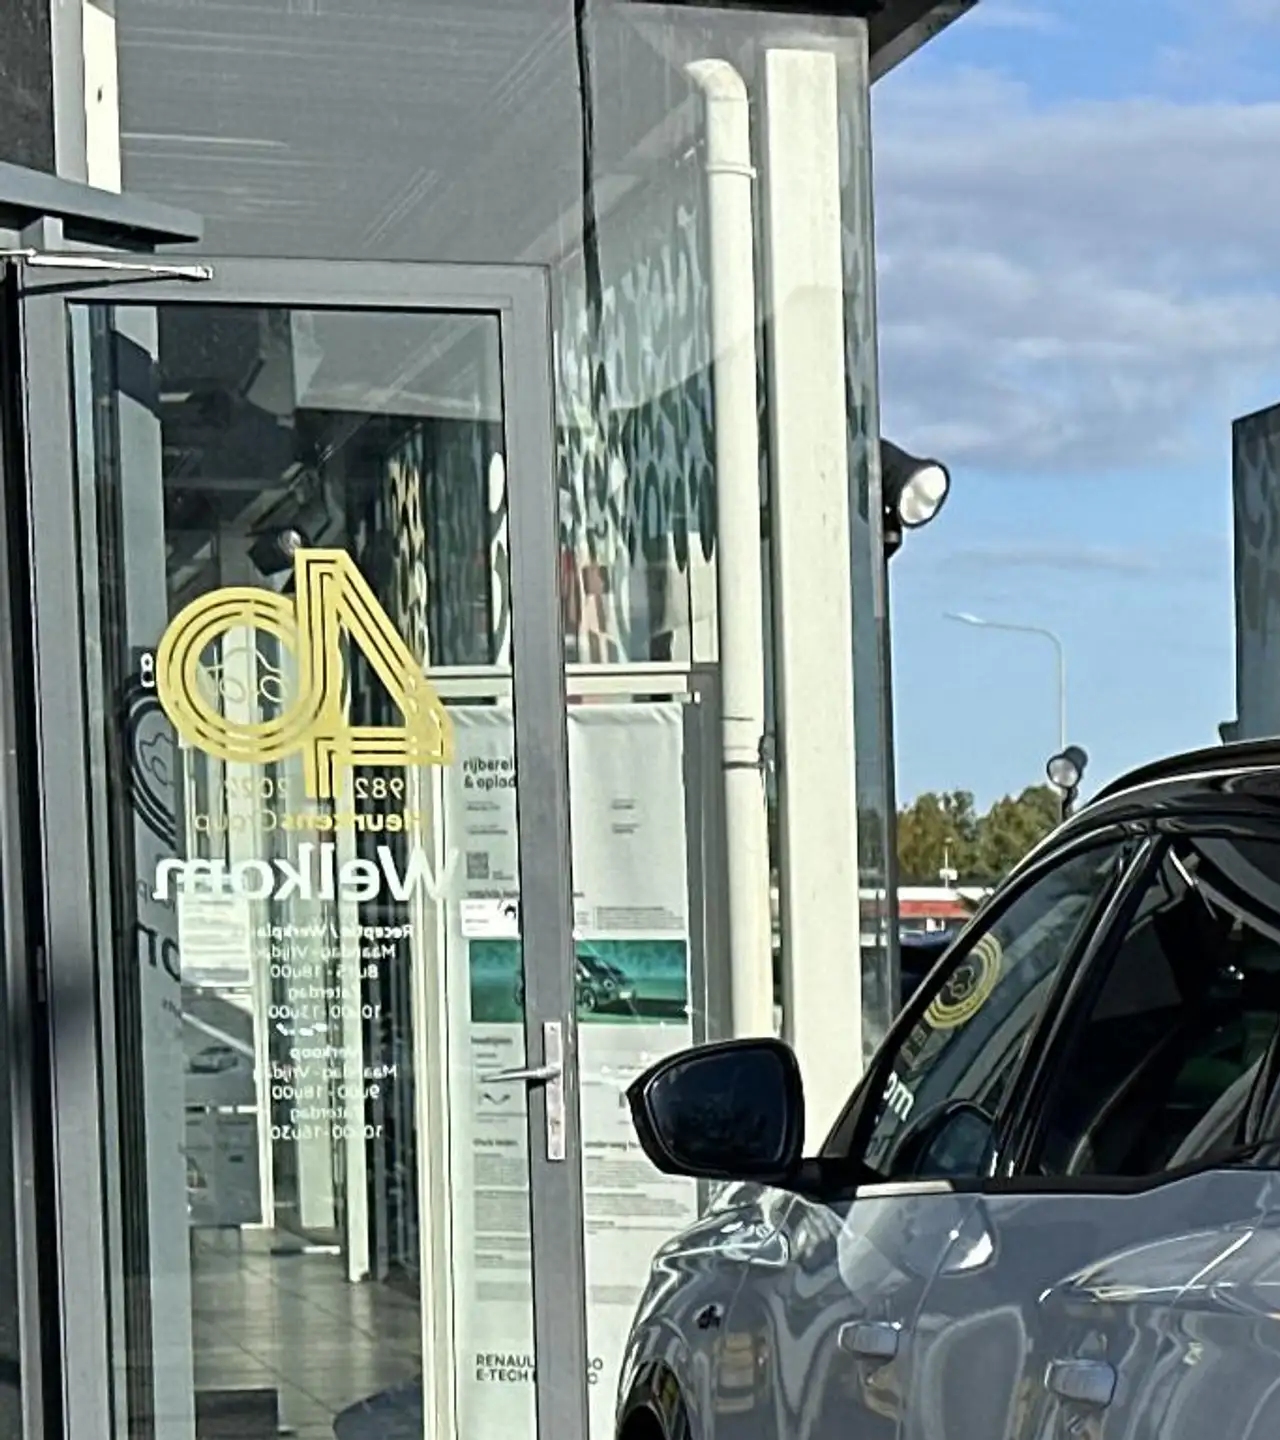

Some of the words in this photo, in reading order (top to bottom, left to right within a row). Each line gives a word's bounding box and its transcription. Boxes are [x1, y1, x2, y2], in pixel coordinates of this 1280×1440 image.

[463, 755, 514, 775] rijberei
[477, 774, 517, 792] oplad
[476, 1353, 535, 1369] RENAUL
